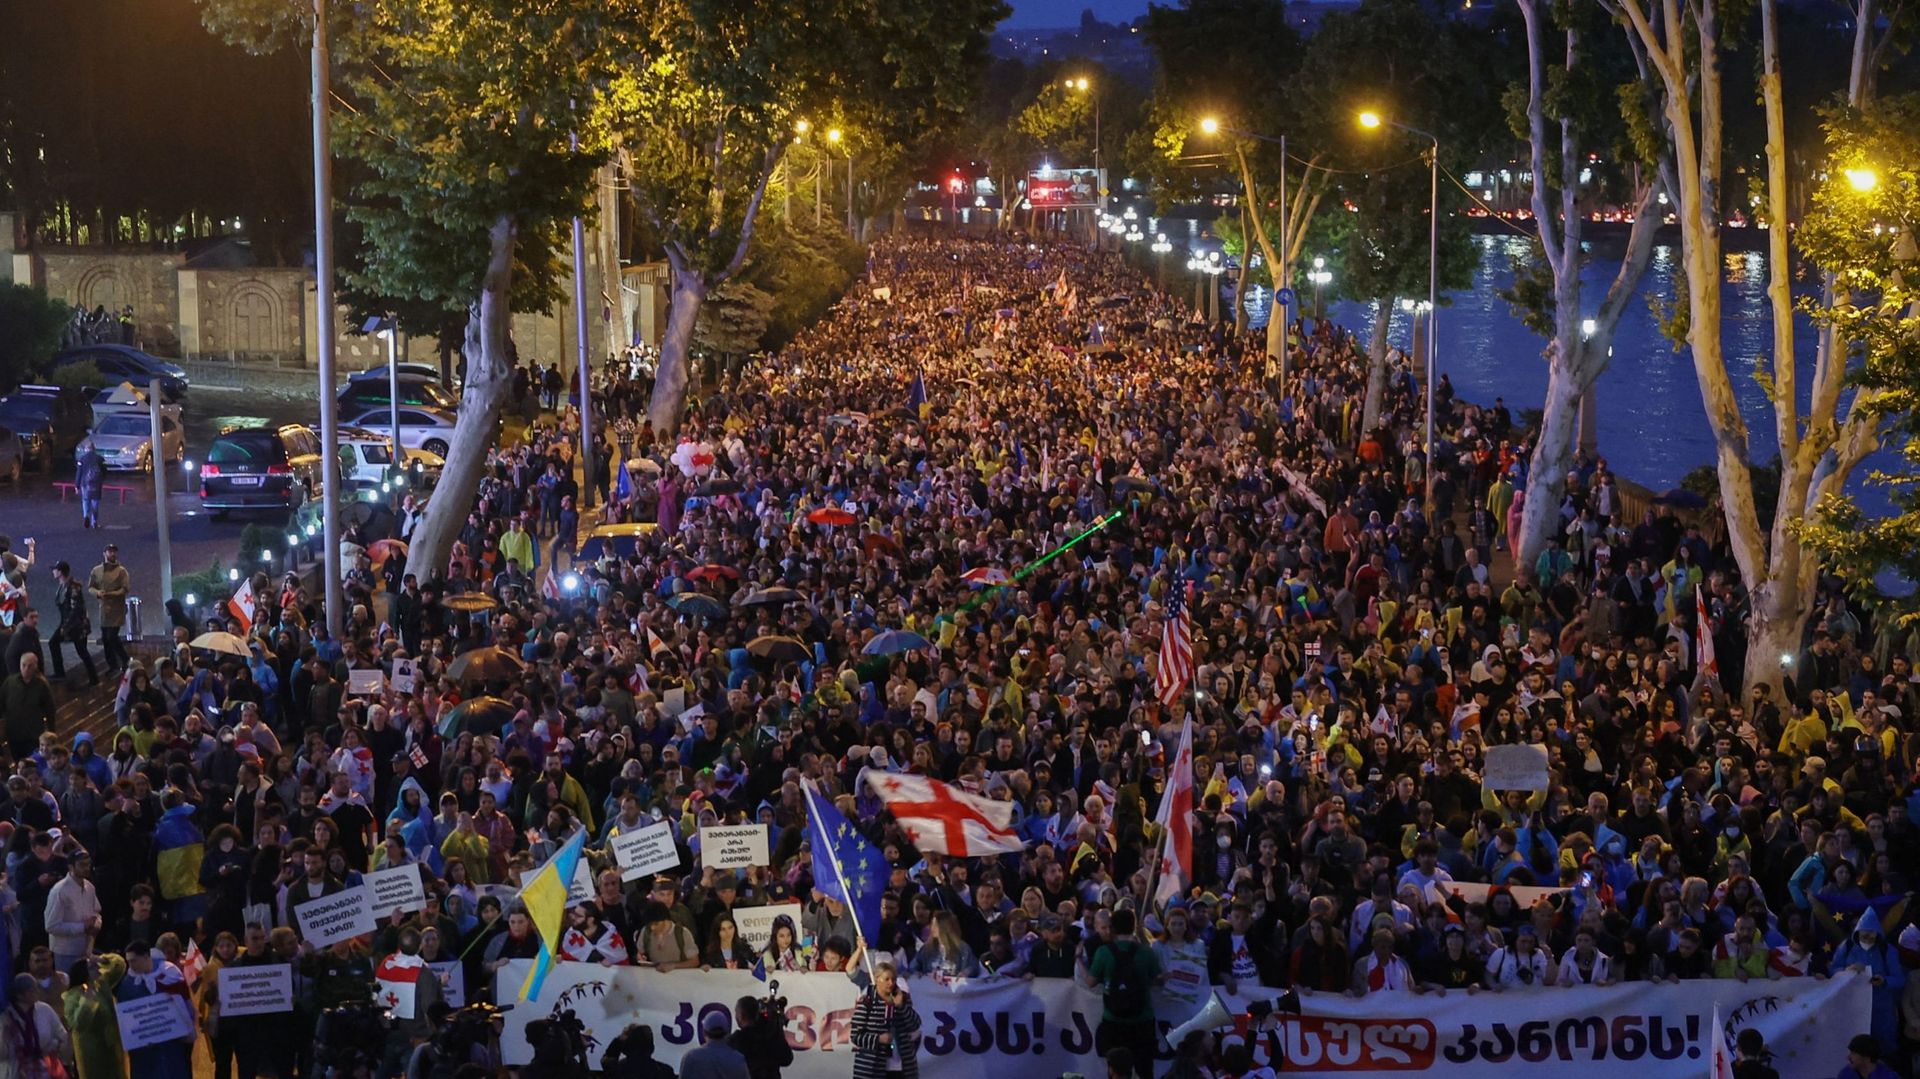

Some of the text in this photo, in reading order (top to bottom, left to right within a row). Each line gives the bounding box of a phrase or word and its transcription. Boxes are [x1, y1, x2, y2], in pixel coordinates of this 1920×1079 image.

[720, 847, 751, 855] რუსულ
[720, 855, 753, 864] კანონს!
[302, 894, 363, 921] ვეტერანები
[309, 907, 362, 930] თქვენთან
[323, 921, 355, 937] ვართ!
[745, 1005, 1046, 1056] ვრპას!
[1443, 1015, 1702, 1064] კანონს!
